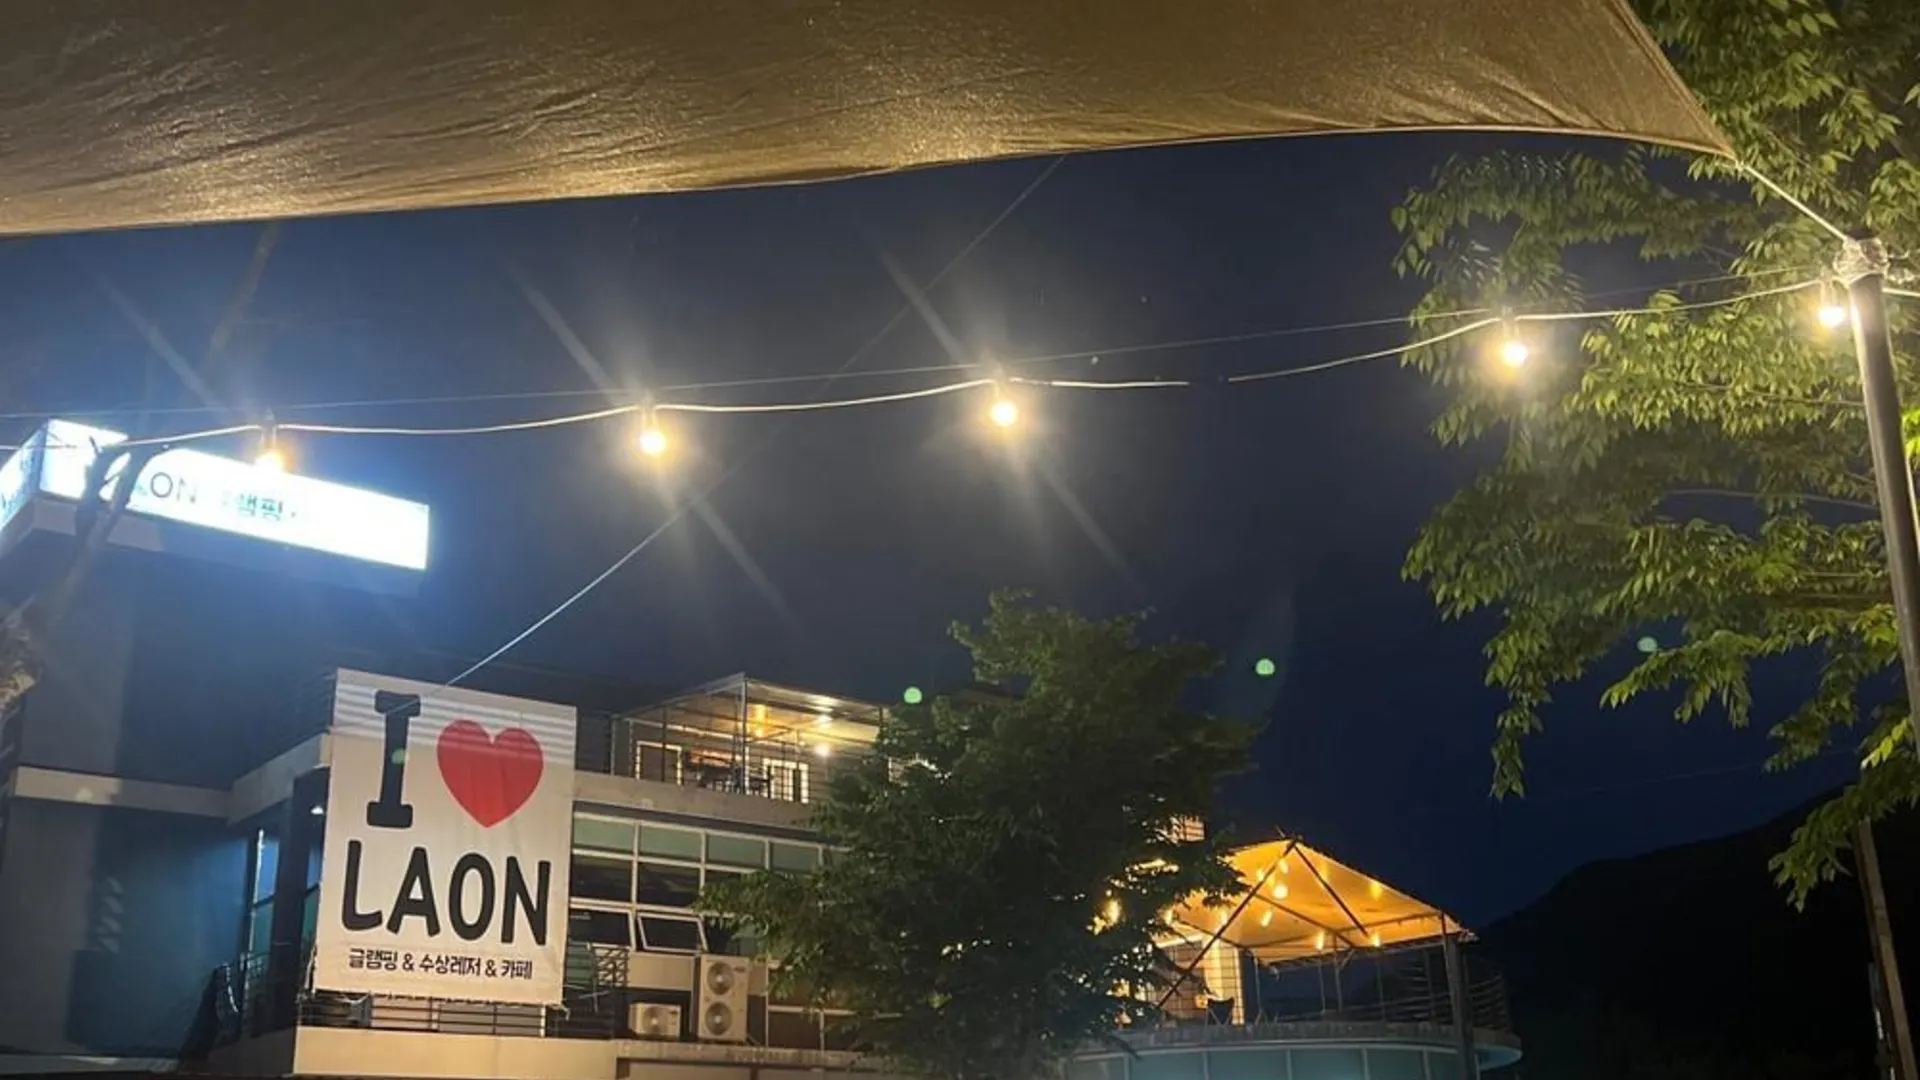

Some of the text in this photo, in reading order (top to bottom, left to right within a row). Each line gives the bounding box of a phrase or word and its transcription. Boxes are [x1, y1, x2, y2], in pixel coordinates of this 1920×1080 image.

[367, 689, 421, 829] I
[341, 839, 551, 946] LAON
[349, 948, 533, 980] 글램핑 & 수상레저 & 카페
